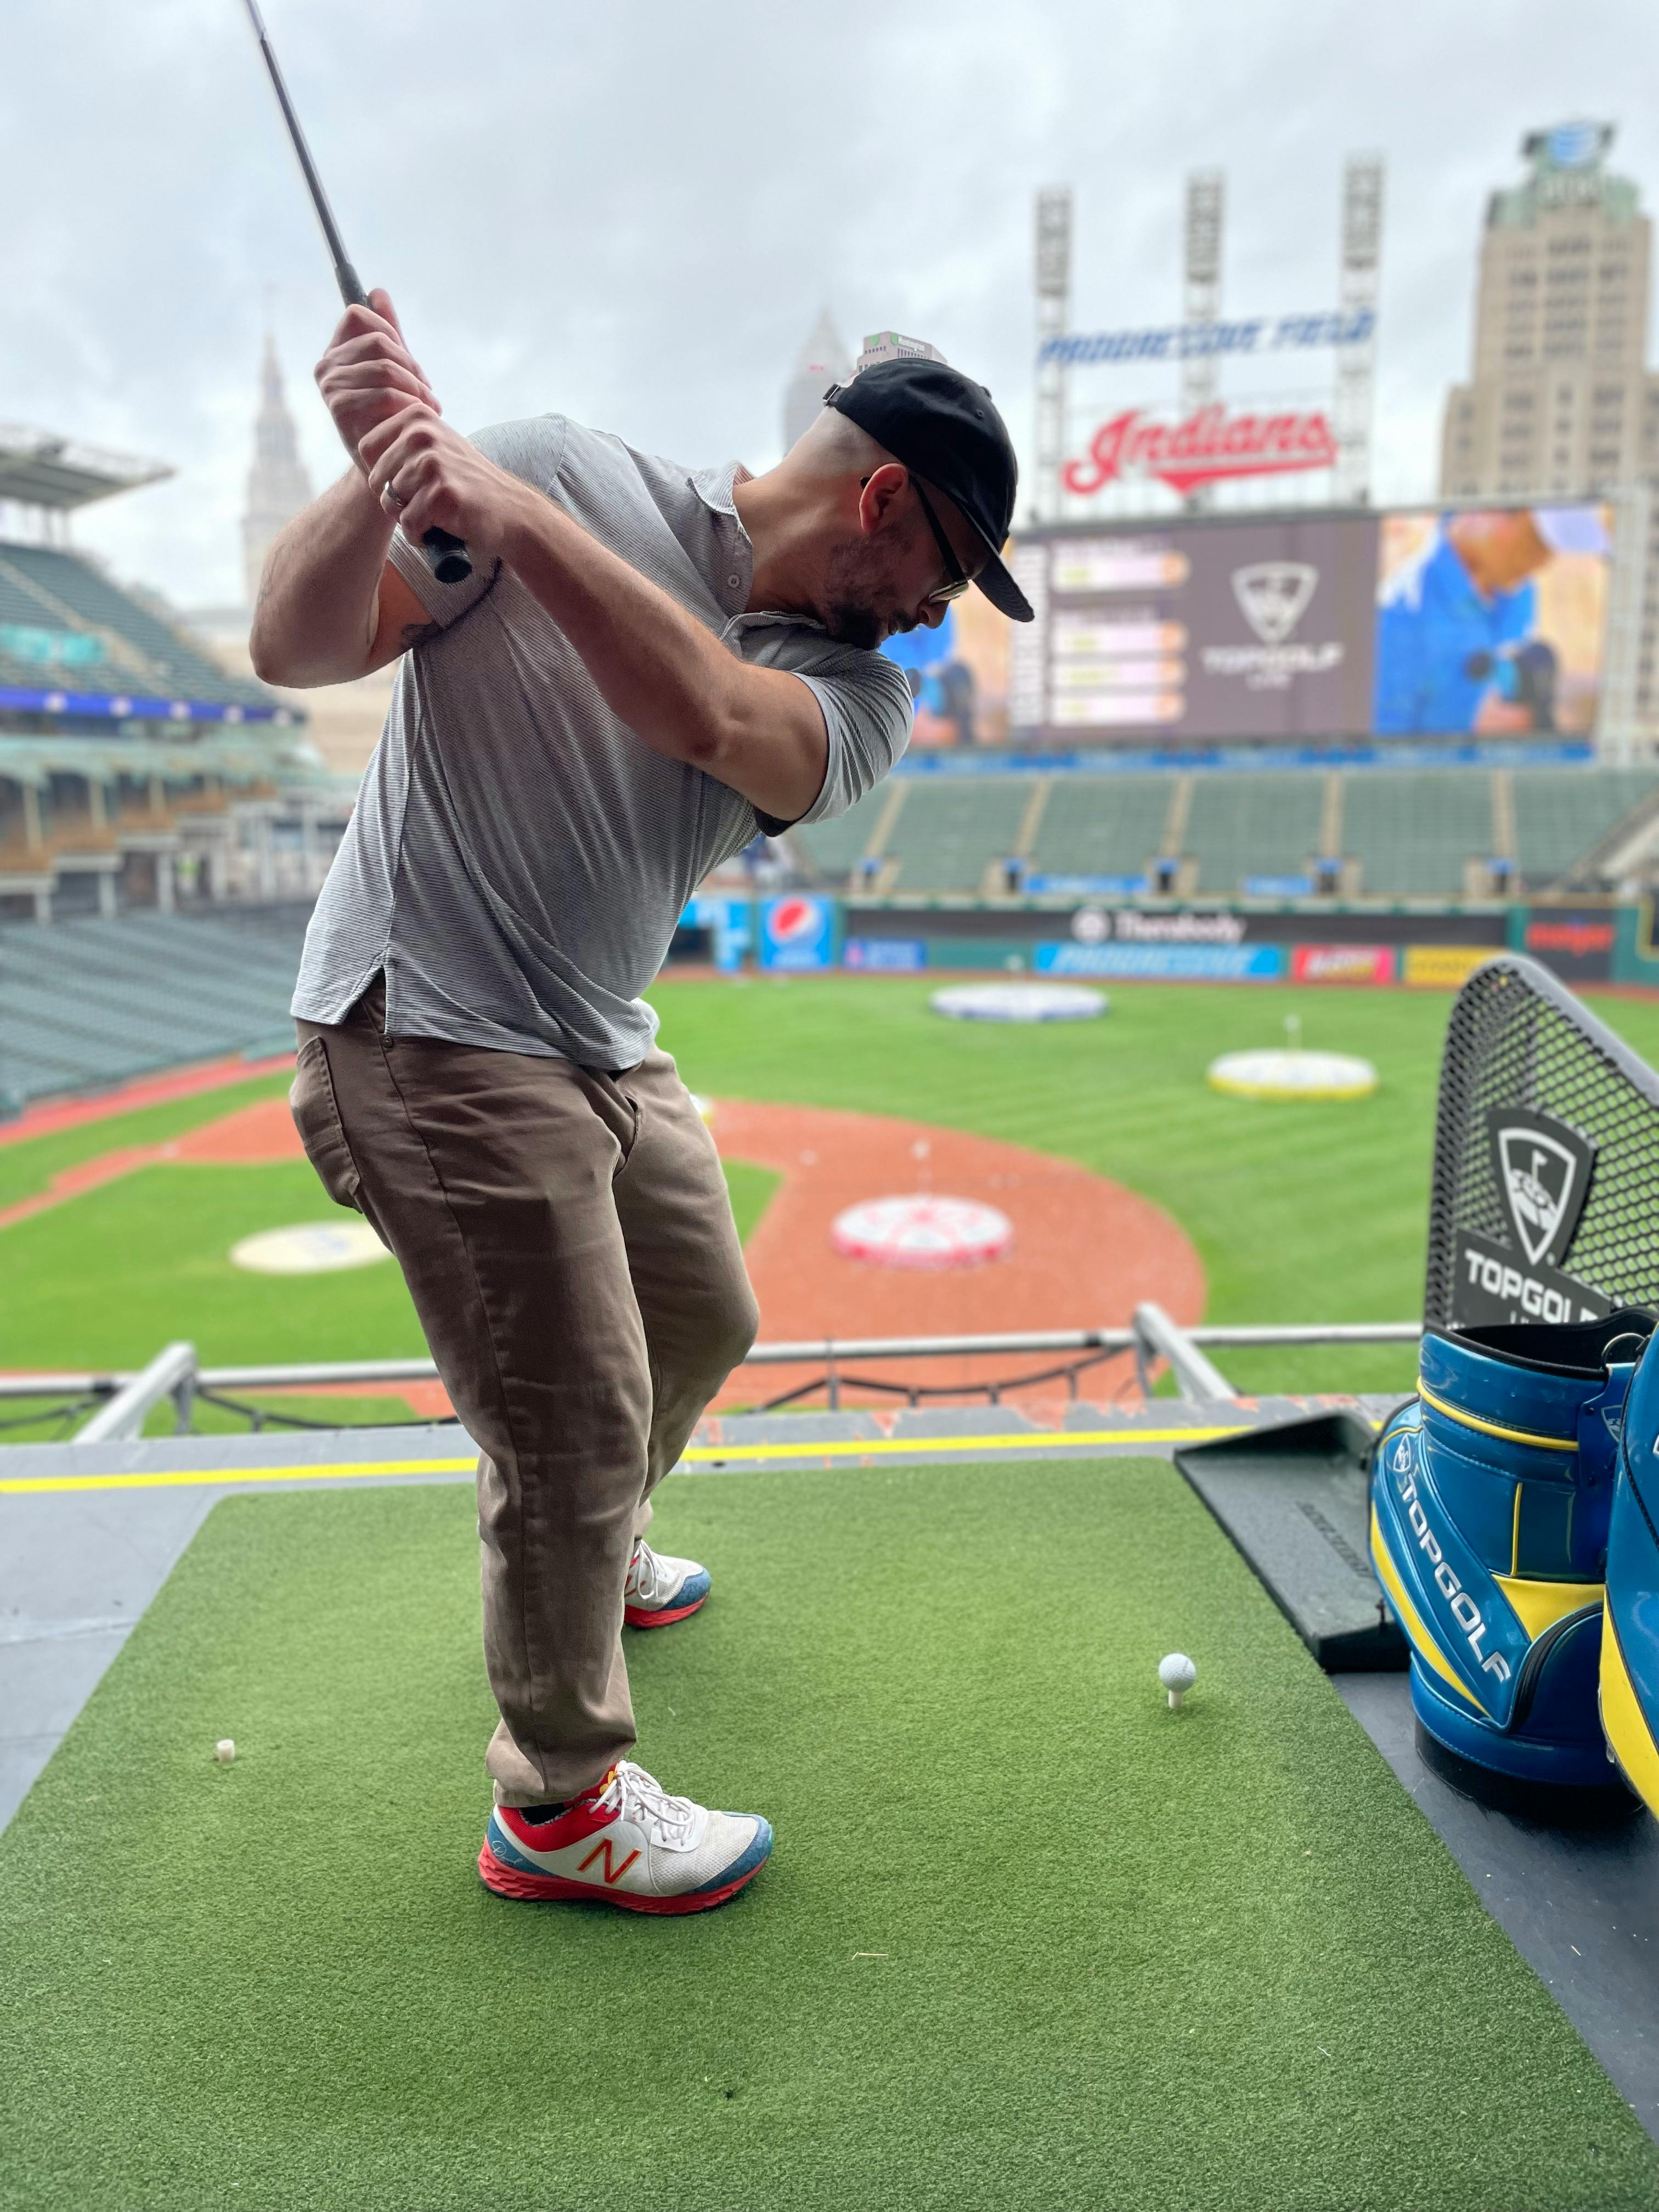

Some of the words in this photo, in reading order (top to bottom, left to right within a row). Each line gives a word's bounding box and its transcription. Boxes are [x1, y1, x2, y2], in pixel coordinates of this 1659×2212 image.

[1061, 404, 1338, 497] Indians
[1115, 907, 1246, 945] Therabody
[1403, 1471, 1511, 1683] TOPGOLF
[576, 1837, 643, 1884] N
